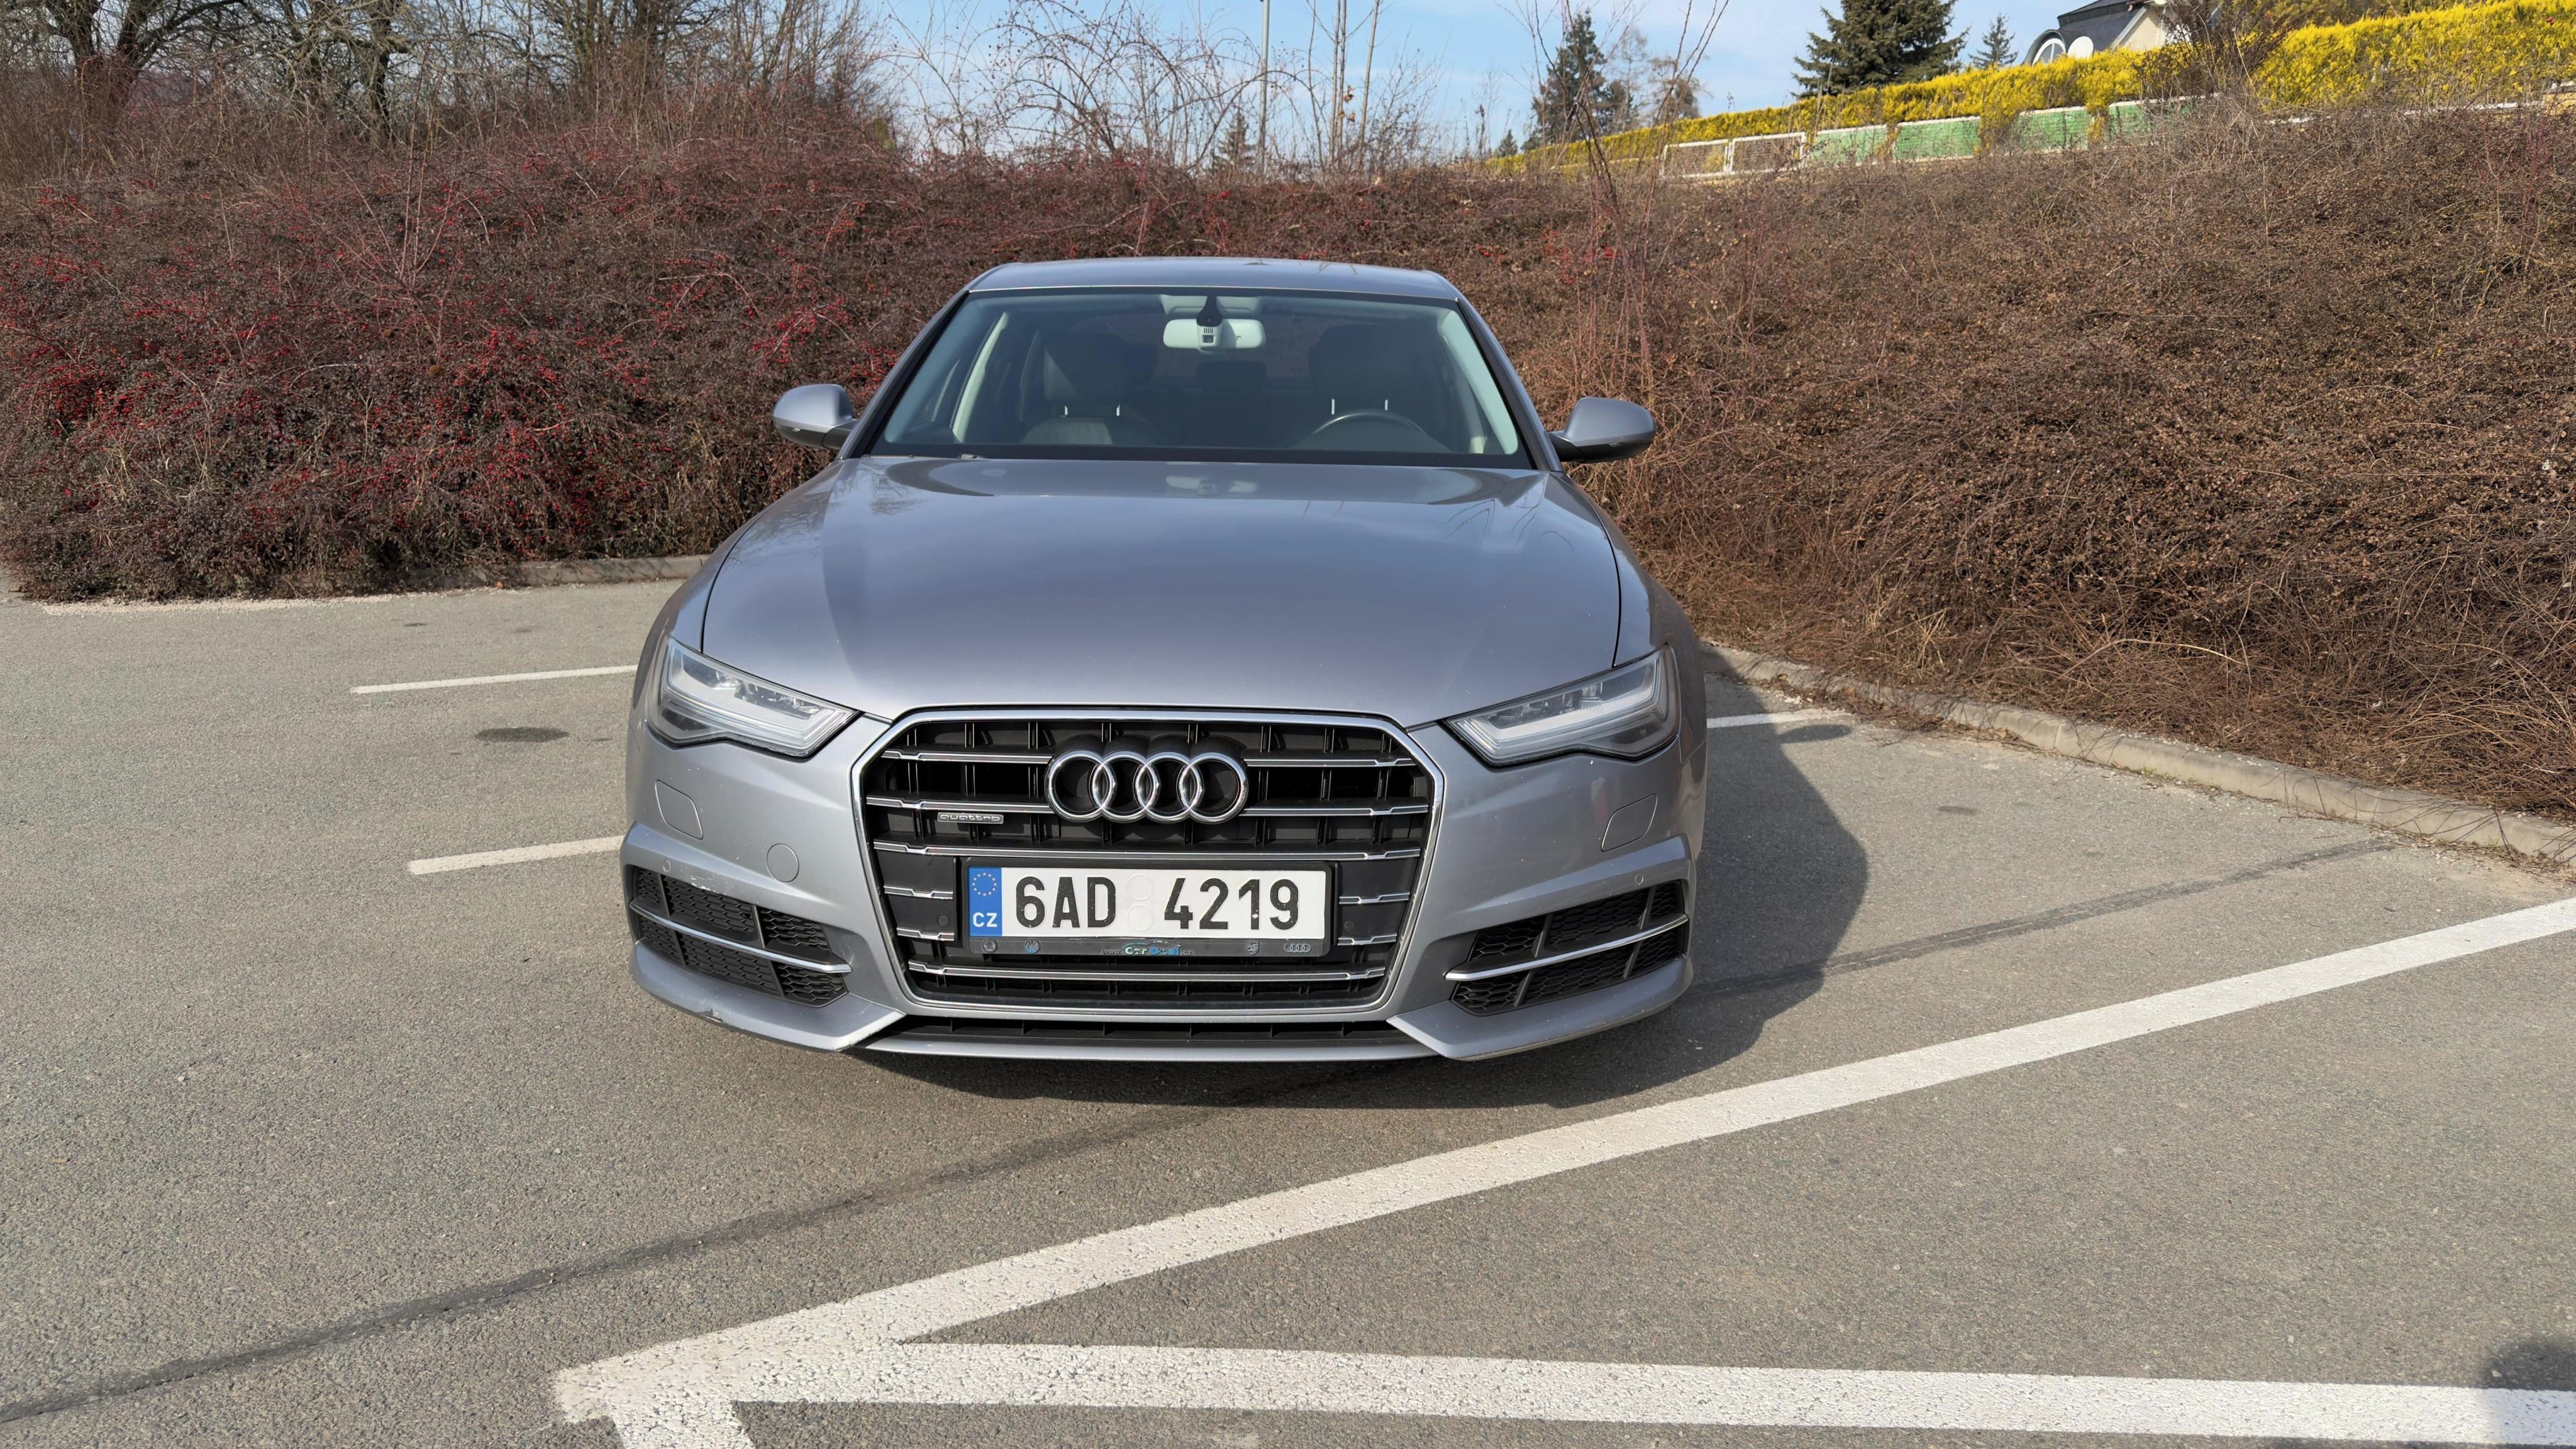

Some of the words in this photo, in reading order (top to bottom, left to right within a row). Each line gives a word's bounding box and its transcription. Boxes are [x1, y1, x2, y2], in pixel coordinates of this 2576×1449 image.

[972, 912, 997, 928] CZ
[1016, 876, 1116, 928] 6AD
[1164, 877, 1299, 930] 4219
